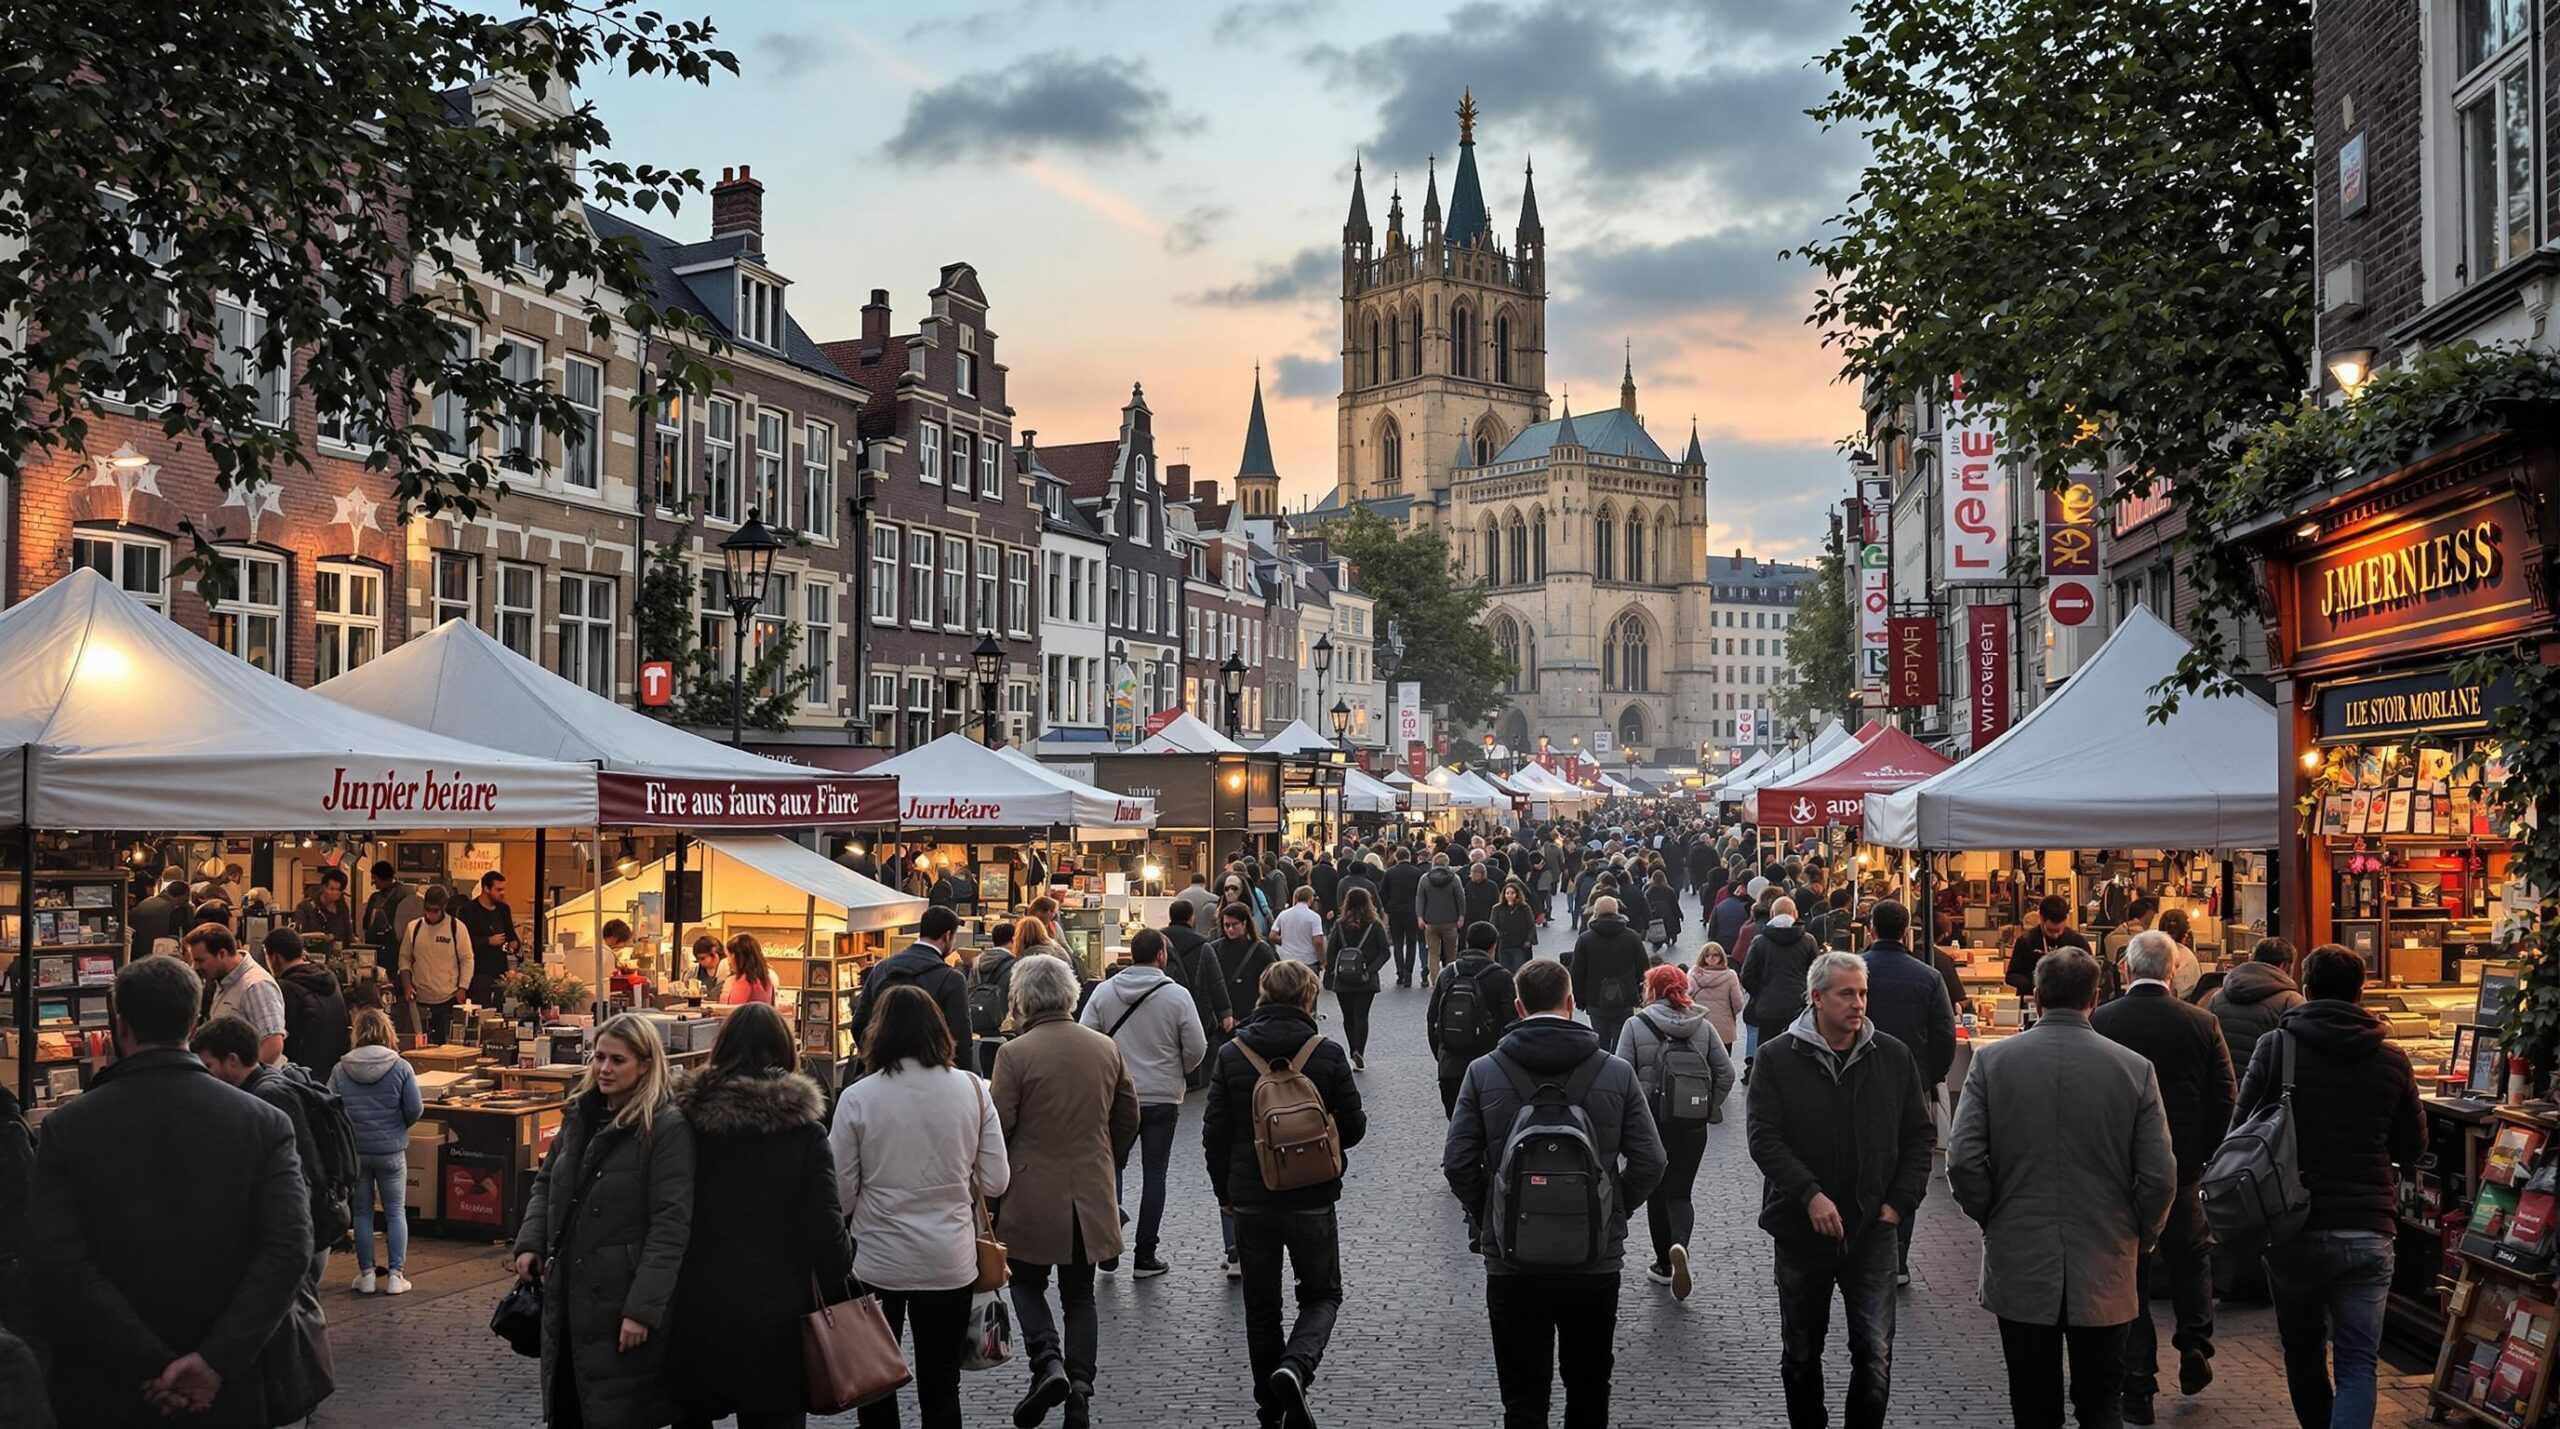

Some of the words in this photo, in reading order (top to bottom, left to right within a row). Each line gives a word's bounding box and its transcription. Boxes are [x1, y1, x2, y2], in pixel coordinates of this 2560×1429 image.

[2345, 700, 2368, 727] LUE
[2370, 694, 2407, 725] STOIR
[2409, 686, 2481, 721] MORLANE
[645, 782, 687, 815] Fire
[692, 792, 724, 815] aus
[780, 793, 812, 815] aux
